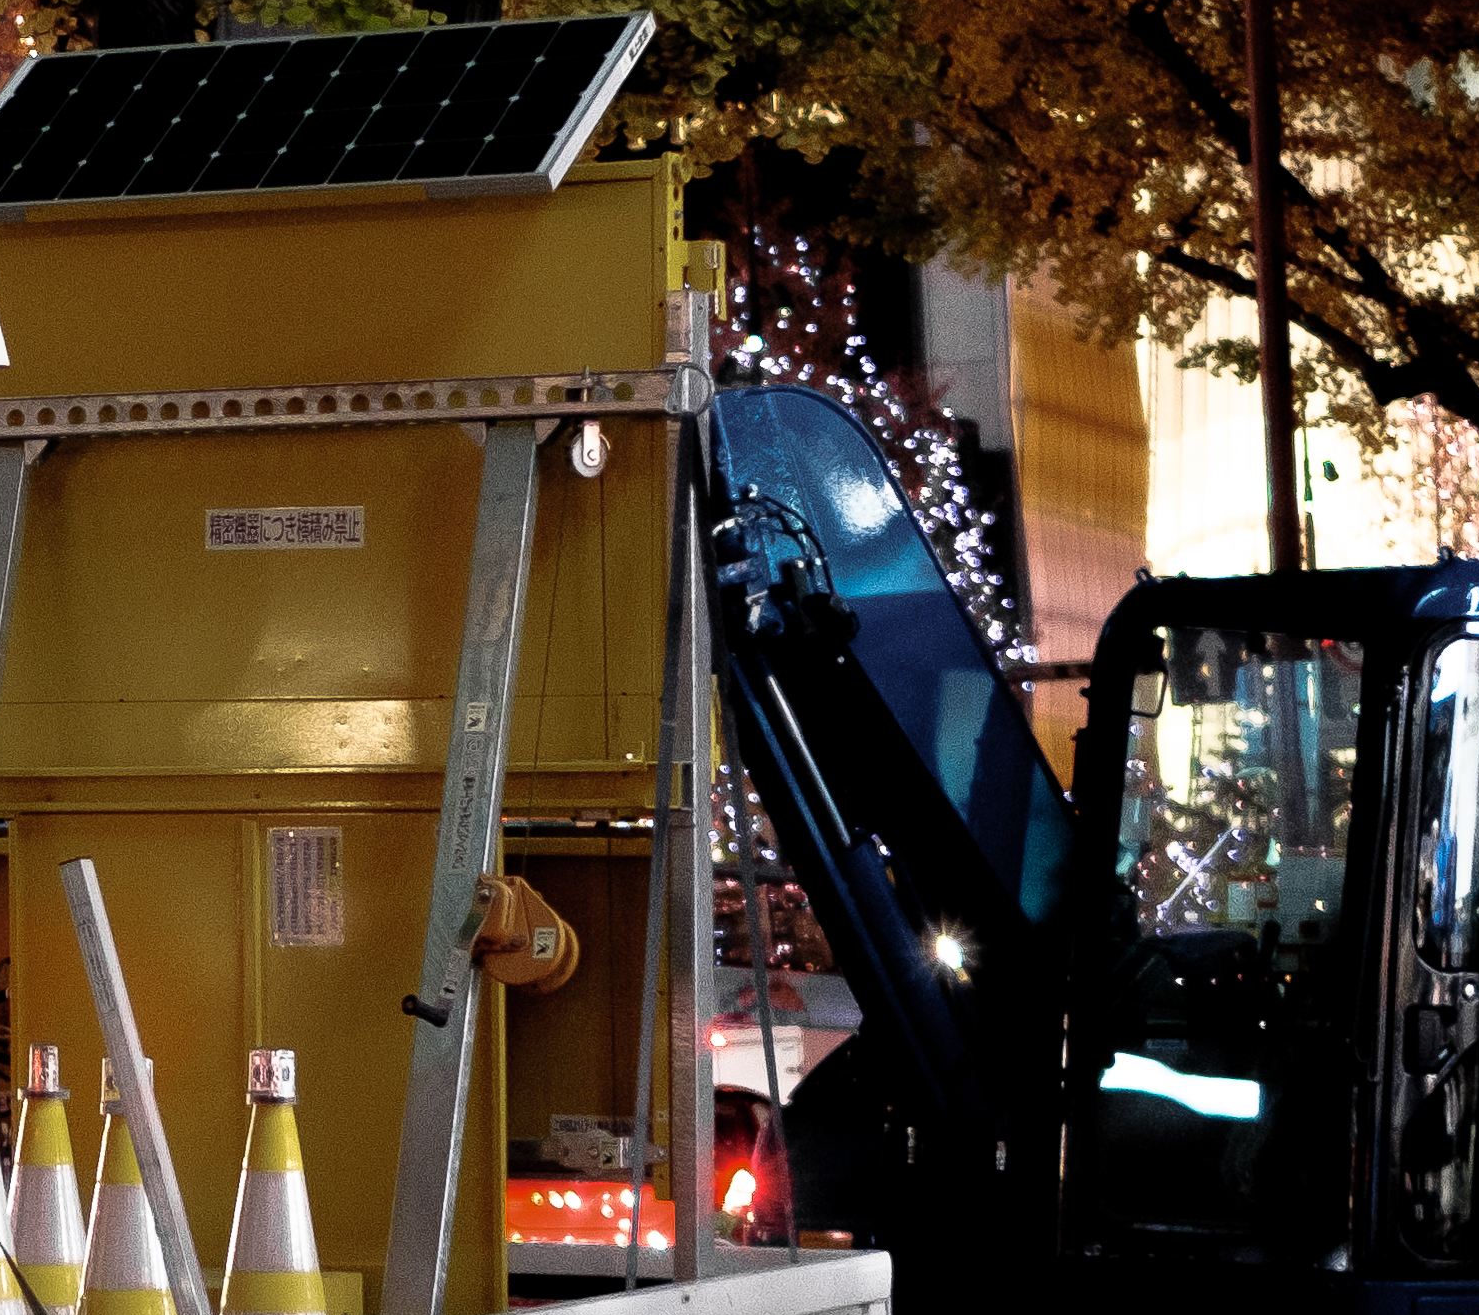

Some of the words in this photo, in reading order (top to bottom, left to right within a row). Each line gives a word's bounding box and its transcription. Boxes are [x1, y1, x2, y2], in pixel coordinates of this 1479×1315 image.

[210, 511, 361, 545] 精密機器につき横積み禁止
